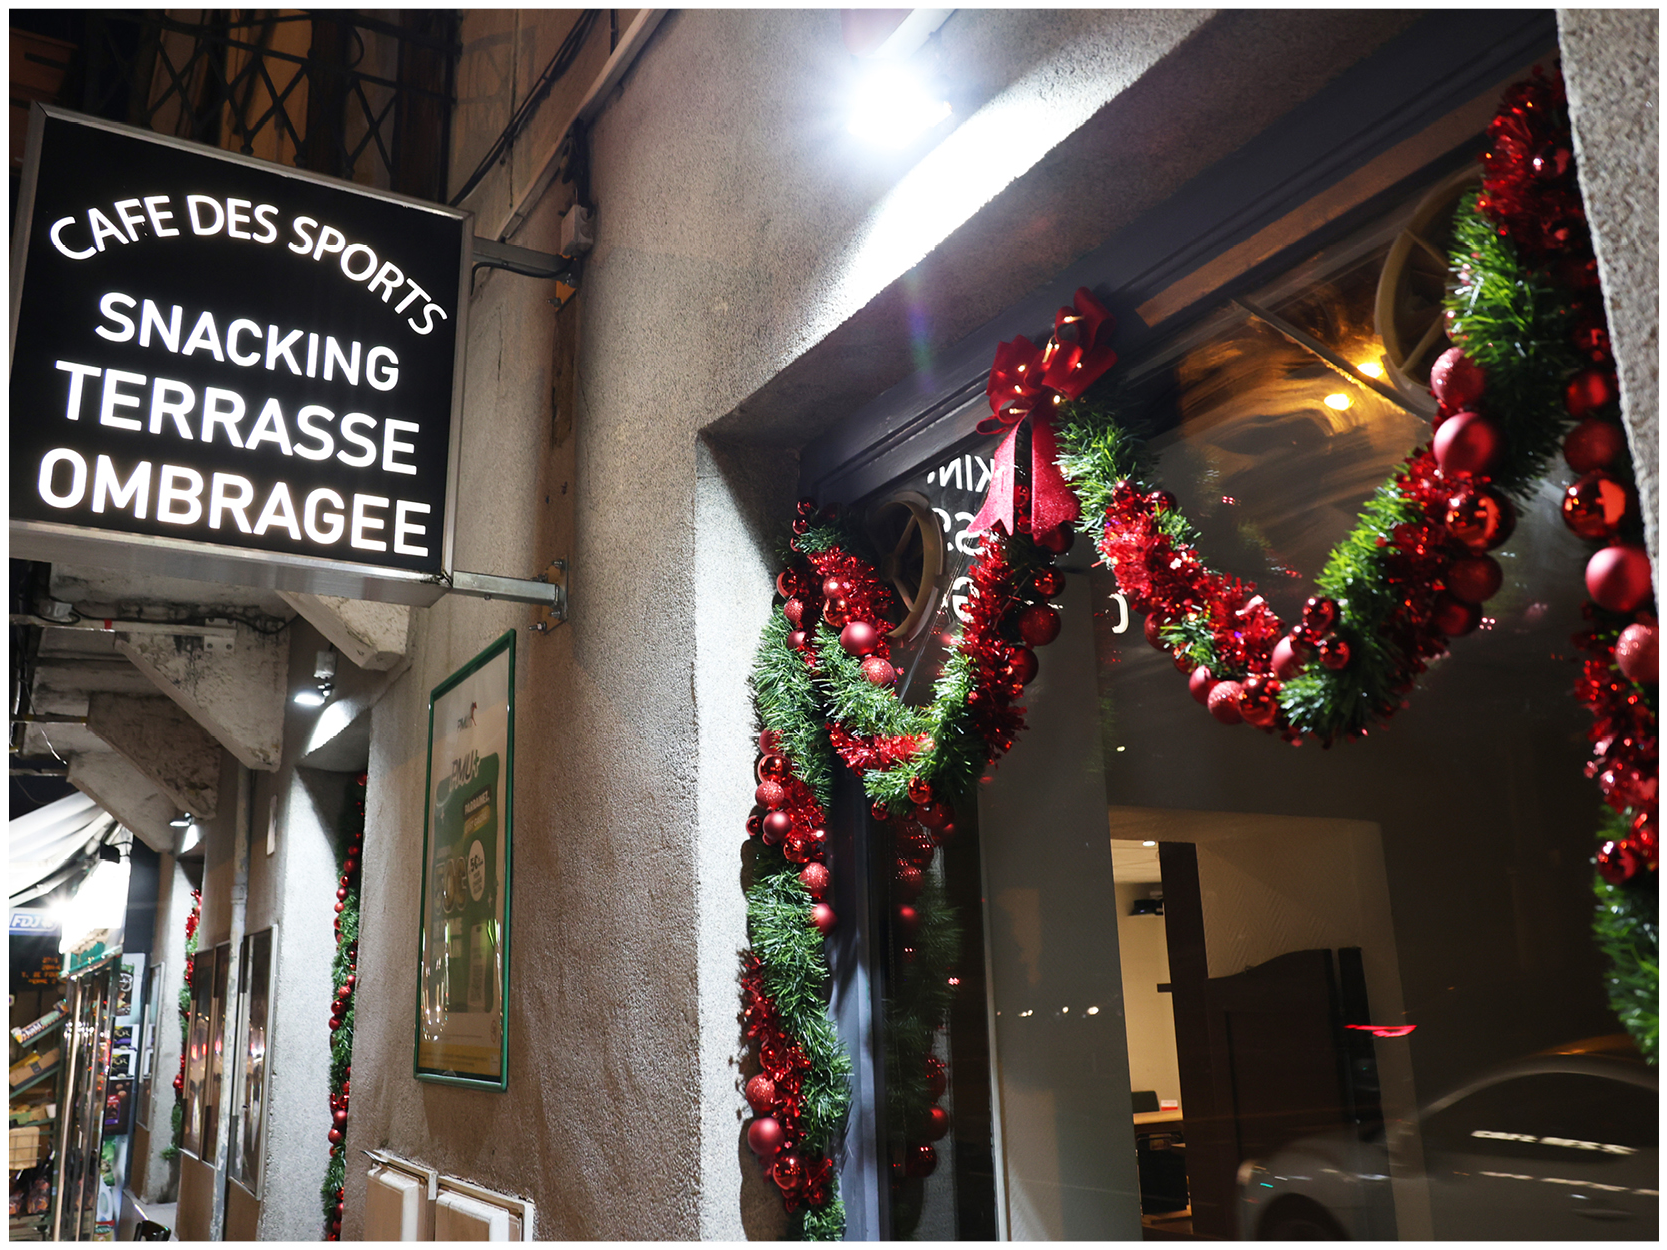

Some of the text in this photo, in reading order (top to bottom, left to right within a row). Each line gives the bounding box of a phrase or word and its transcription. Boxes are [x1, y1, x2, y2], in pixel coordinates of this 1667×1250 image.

[49, 194, 449, 337] CAFE DES SPORTS
[94, 291, 400, 392] SNACKING
[54, 359, 421, 477] TERRASSE
[37, 447, 432, 558] OMBRAGEE
